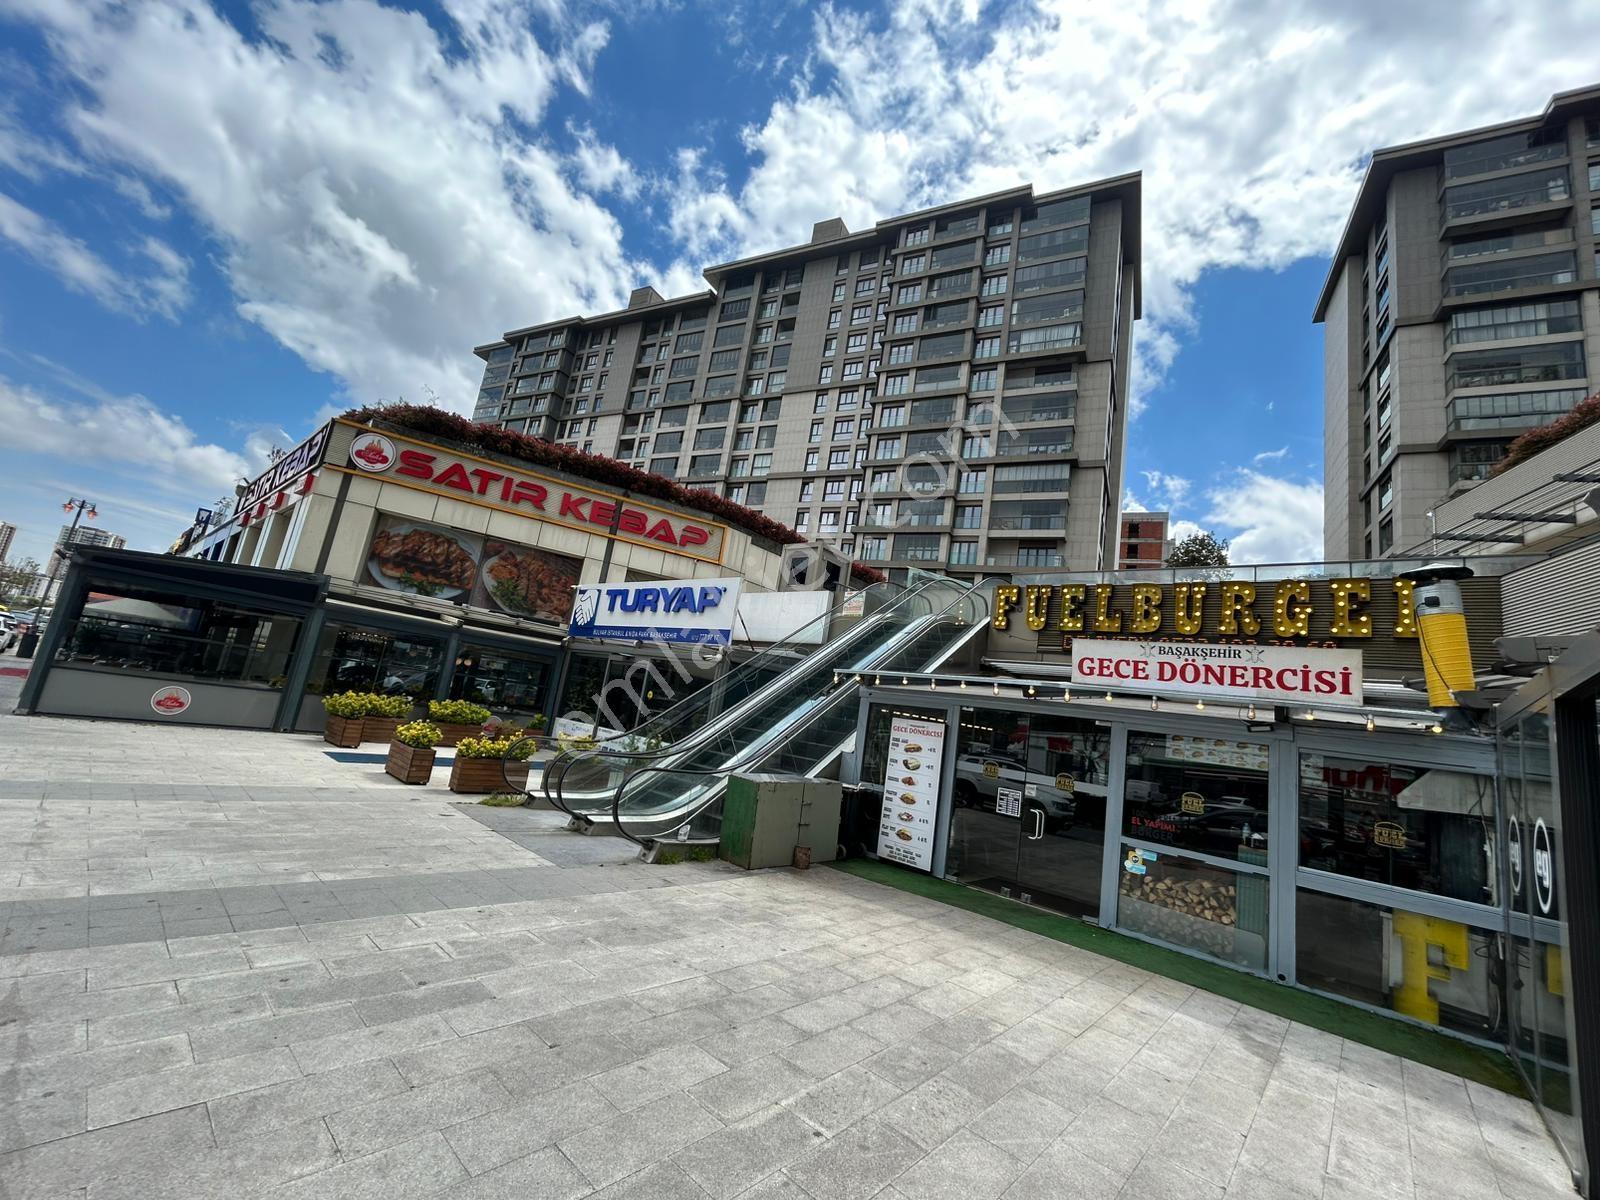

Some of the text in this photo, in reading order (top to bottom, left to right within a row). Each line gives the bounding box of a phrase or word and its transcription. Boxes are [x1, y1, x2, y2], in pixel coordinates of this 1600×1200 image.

[396, 449, 710, 548] SATIR KEBAP
[606, 586, 723, 614] TURYAP
[1157, 644, 1242, 660] BAŞAKŞEHİR
[1077, 656, 1353, 696] GECE DÖNERCİSİ
